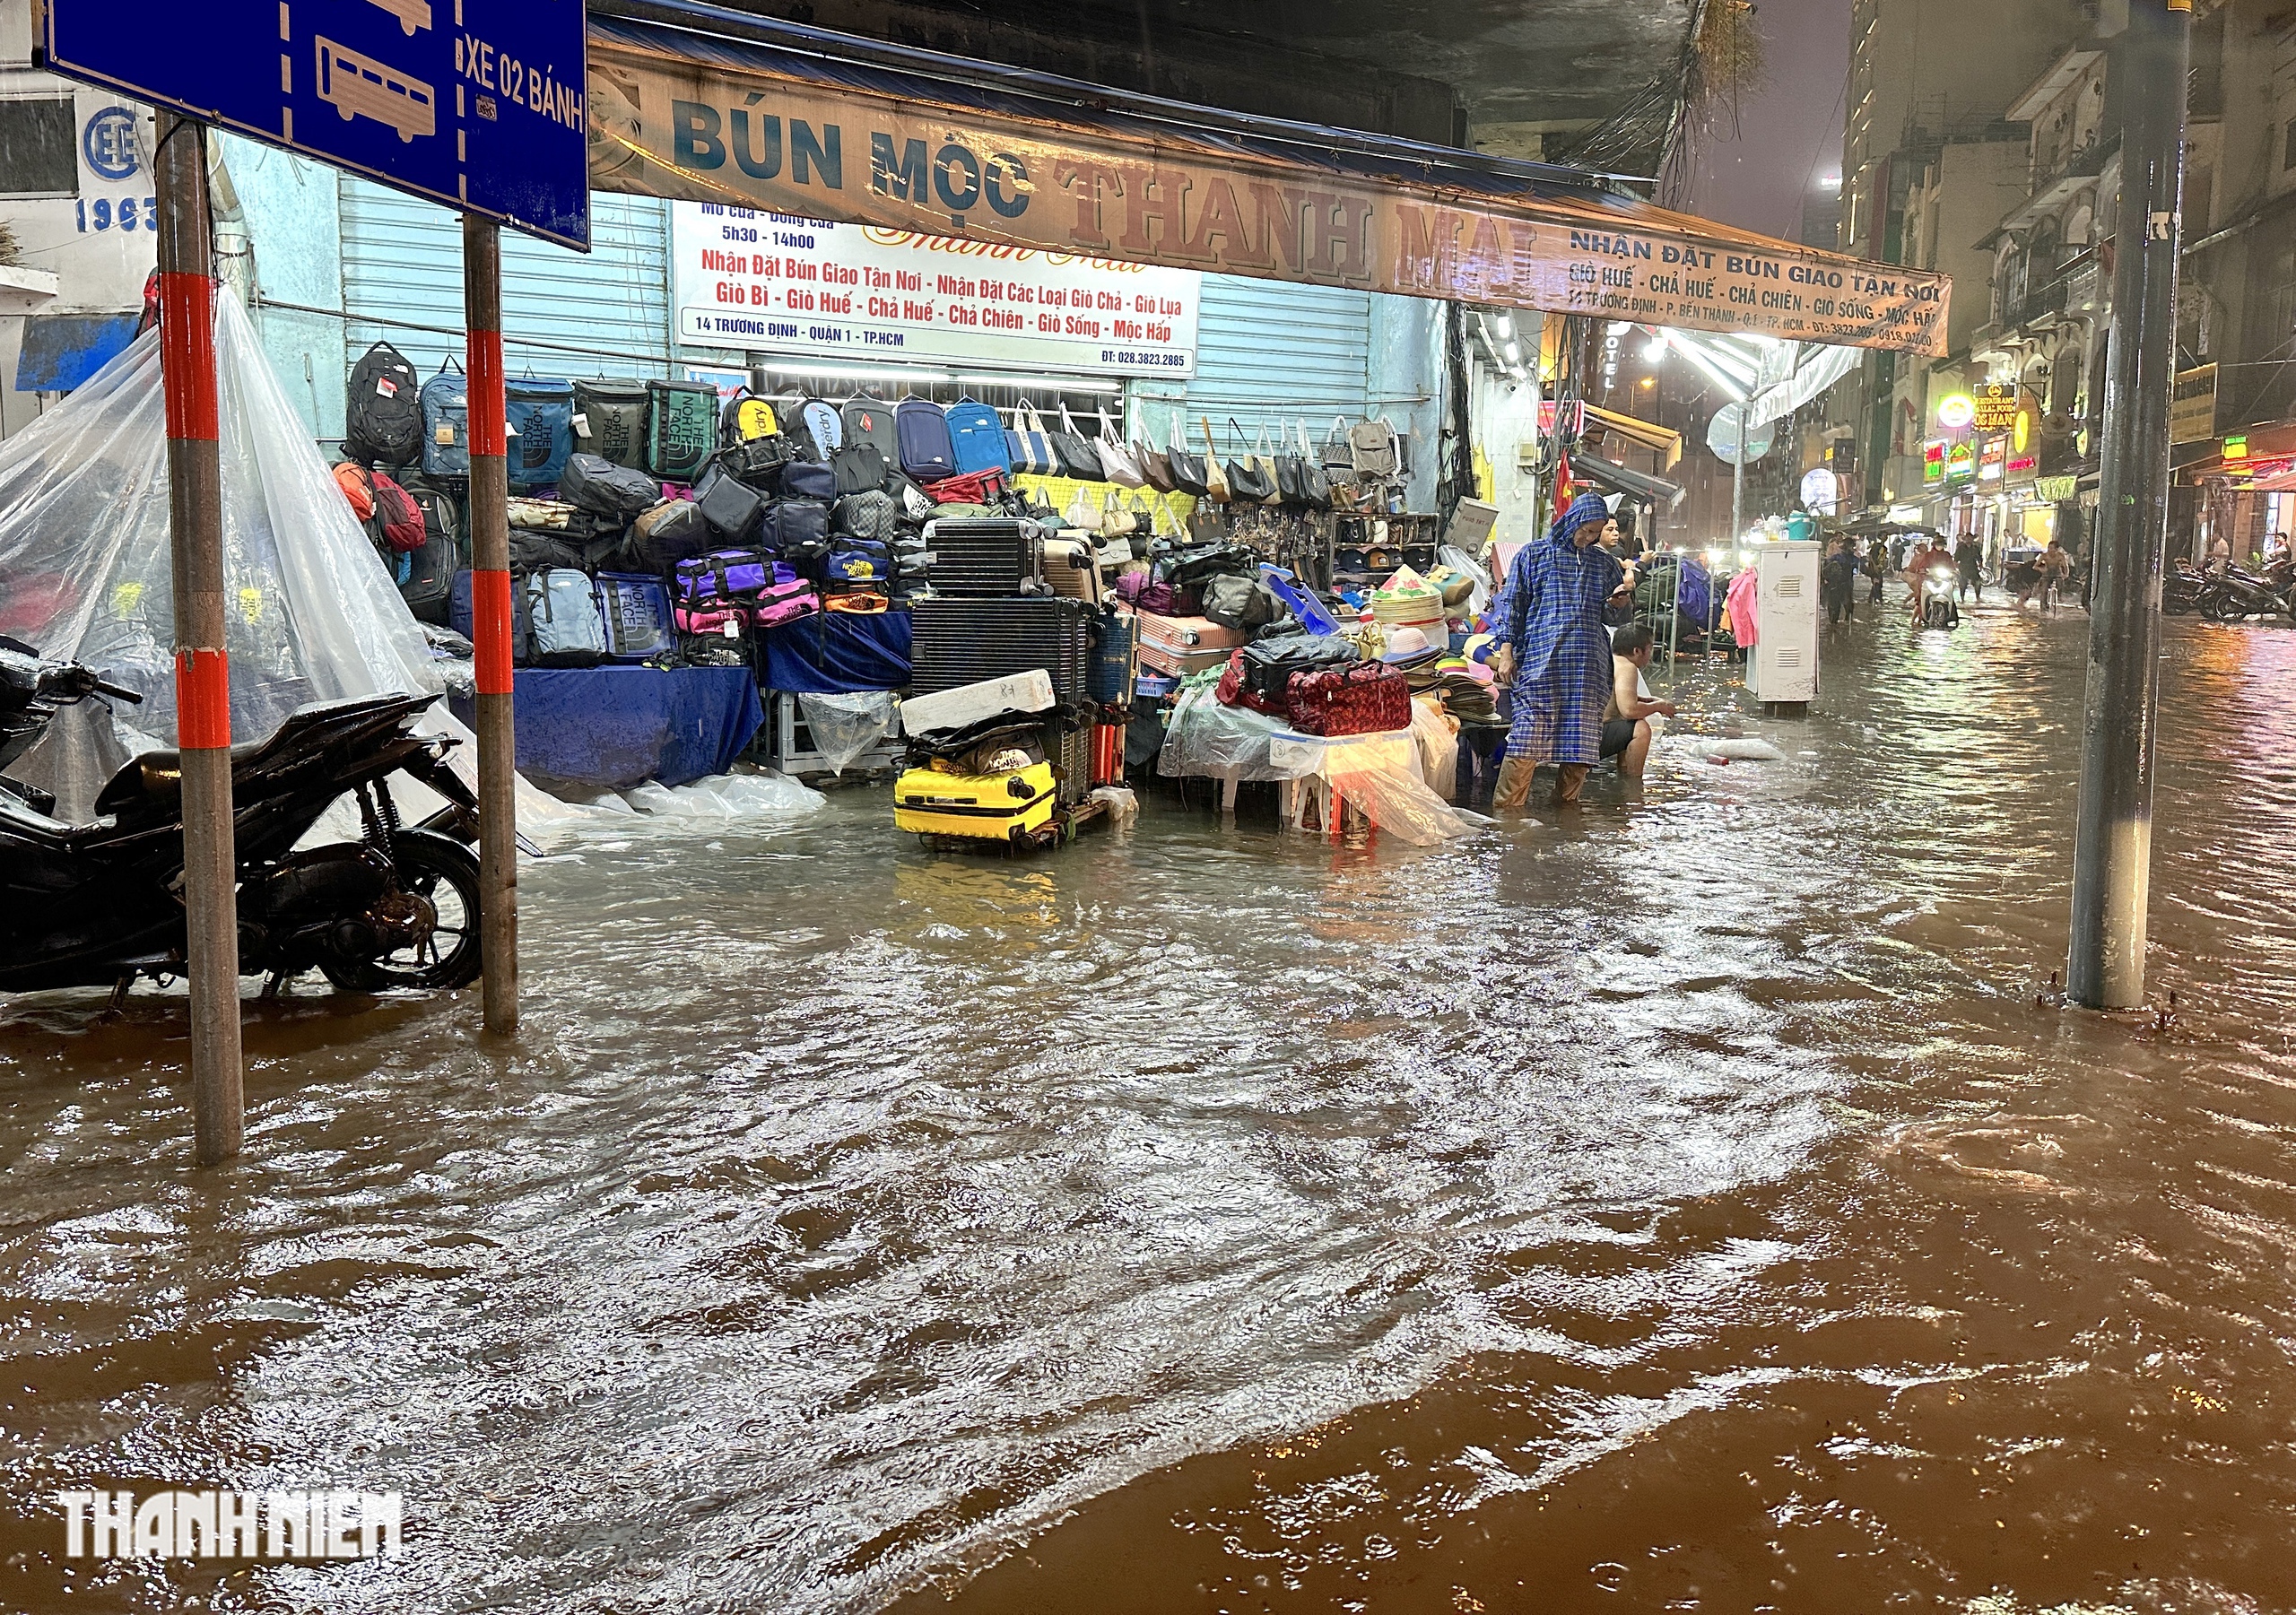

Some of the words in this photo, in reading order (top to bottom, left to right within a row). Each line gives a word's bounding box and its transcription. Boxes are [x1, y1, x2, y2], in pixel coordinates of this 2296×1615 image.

[465, 33, 494, 90] XE
[500, 54, 524, 105] 02
[529, 65, 583, 134] BÁNH
[672, 92, 842, 189] BÚN
[870, 131, 1031, 228] MỘC
[1053, 159, 1372, 280] THANH
[1396, 204, 1536, 300] MAI
[722, 225, 757, 242] 5h30
[772, 231, 814, 249] 14h00
[1570, 230, 1651, 260] NHẬN
[1662, 246, 1716, 271] ĐẶT
[1726, 255, 1779, 280] BÚN
[1788, 265, 1842, 288] GIAO
[1850, 274, 1896, 297] TẬN
[1904, 284, 1939, 302] NƠI
[701, 249, 746, 276] Nhận
[752, 255, 780, 281] Đặt
[786, 258, 816, 282] Bún
[822, 262, 858, 285] Giao
[863, 266, 891, 291] Tận
[897, 270, 921, 292] Nơi
[937, 274, 974, 300] Nhận
[979, 279, 1003, 303] Đặt
[1007, 282, 1033, 303] Các
[1039, 285, 1067, 309] Loại
[1071, 289, 1092, 308] Giò
[1097, 291, 1121, 311] Chả
[1135, 294, 1155, 314] Giò
[1160, 297, 1181, 319] Lụa
[1570, 261, 1596, 283] GIÒ
[1602, 265, 1637, 289] HUẾ
[1649, 271, 1679, 295] CHẢ
[1685, 276, 1717, 300] HUẾ
[1729, 282, 1756, 305] CHẢ
[1761, 289, 1801, 312] CHIÊN
[1813, 296, 1834, 317] GIÒ
[1838, 298, 1874, 319] SỐNG
[1885, 305, 1909, 326] MỘC
[717, 282, 744, 304] Giò
[752, 285, 768, 307] Bì
[787, 289, 814, 310] Giò
[820, 291, 854, 315] Huế
[868, 296, 898, 318] Chả
[904, 300, 935, 321] Huế
[949, 304, 976, 326] Chả
[982, 307, 1023, 330] Chiên
[1038, 312, 1060, 334] Giò
[1065, 314, 1100, 338] Sống
[1114, 319, 1143, 343] Mộc
[1146, 319, 1171, 343] Hấp
[1586, 291, 1629, 310] TRƯƠNG
[1631, 298, 1656, 315] ĐỊNH
[1666, 303, 1675, 316] P.
[1679, 300, 1700, 318] BẾN
[1702, 305, 1735, 323] THÀNH
[1744, 312, 1758, 327] Q.1
[1783, 317, 1805, 331] HCM
[1812, 321, 1830, 334] ĐT:
[696, 316, 710, 331] 14
[715, 317, 764, 335] TRƯƠNG
[768, 323, 797, 338] ĐỊNH
[809, 326, 841, 343] QUẬN
[845, 330, 850, 343] 1
[863, 330, 904, 346] TP.HCM
[1101, 351, 1116, 362] ĐT:
[1118, 352, 1184, 367] 028.3823.2885
[523, 418, 533, 447] FACE
[533, 406, 544, 447] NORTH
[544, 424, 552, 447] THE
[603, 418, 612, 447] FACE
[612, 407, 621, 447] NORTH
[621, 424, 630, 447] THE
[669, 409, 682, 445] FACE
[682, 396, 694, 446] NORTH
[692, 420, 705, 446] THE
[239, 595, 248, 612] THE
[621, 594, 636, 625] FACE
[631, 584, 648, 626] NORTH
[787, 604, 802, 613] THE
[1000, 750, 1015, 759] THE
